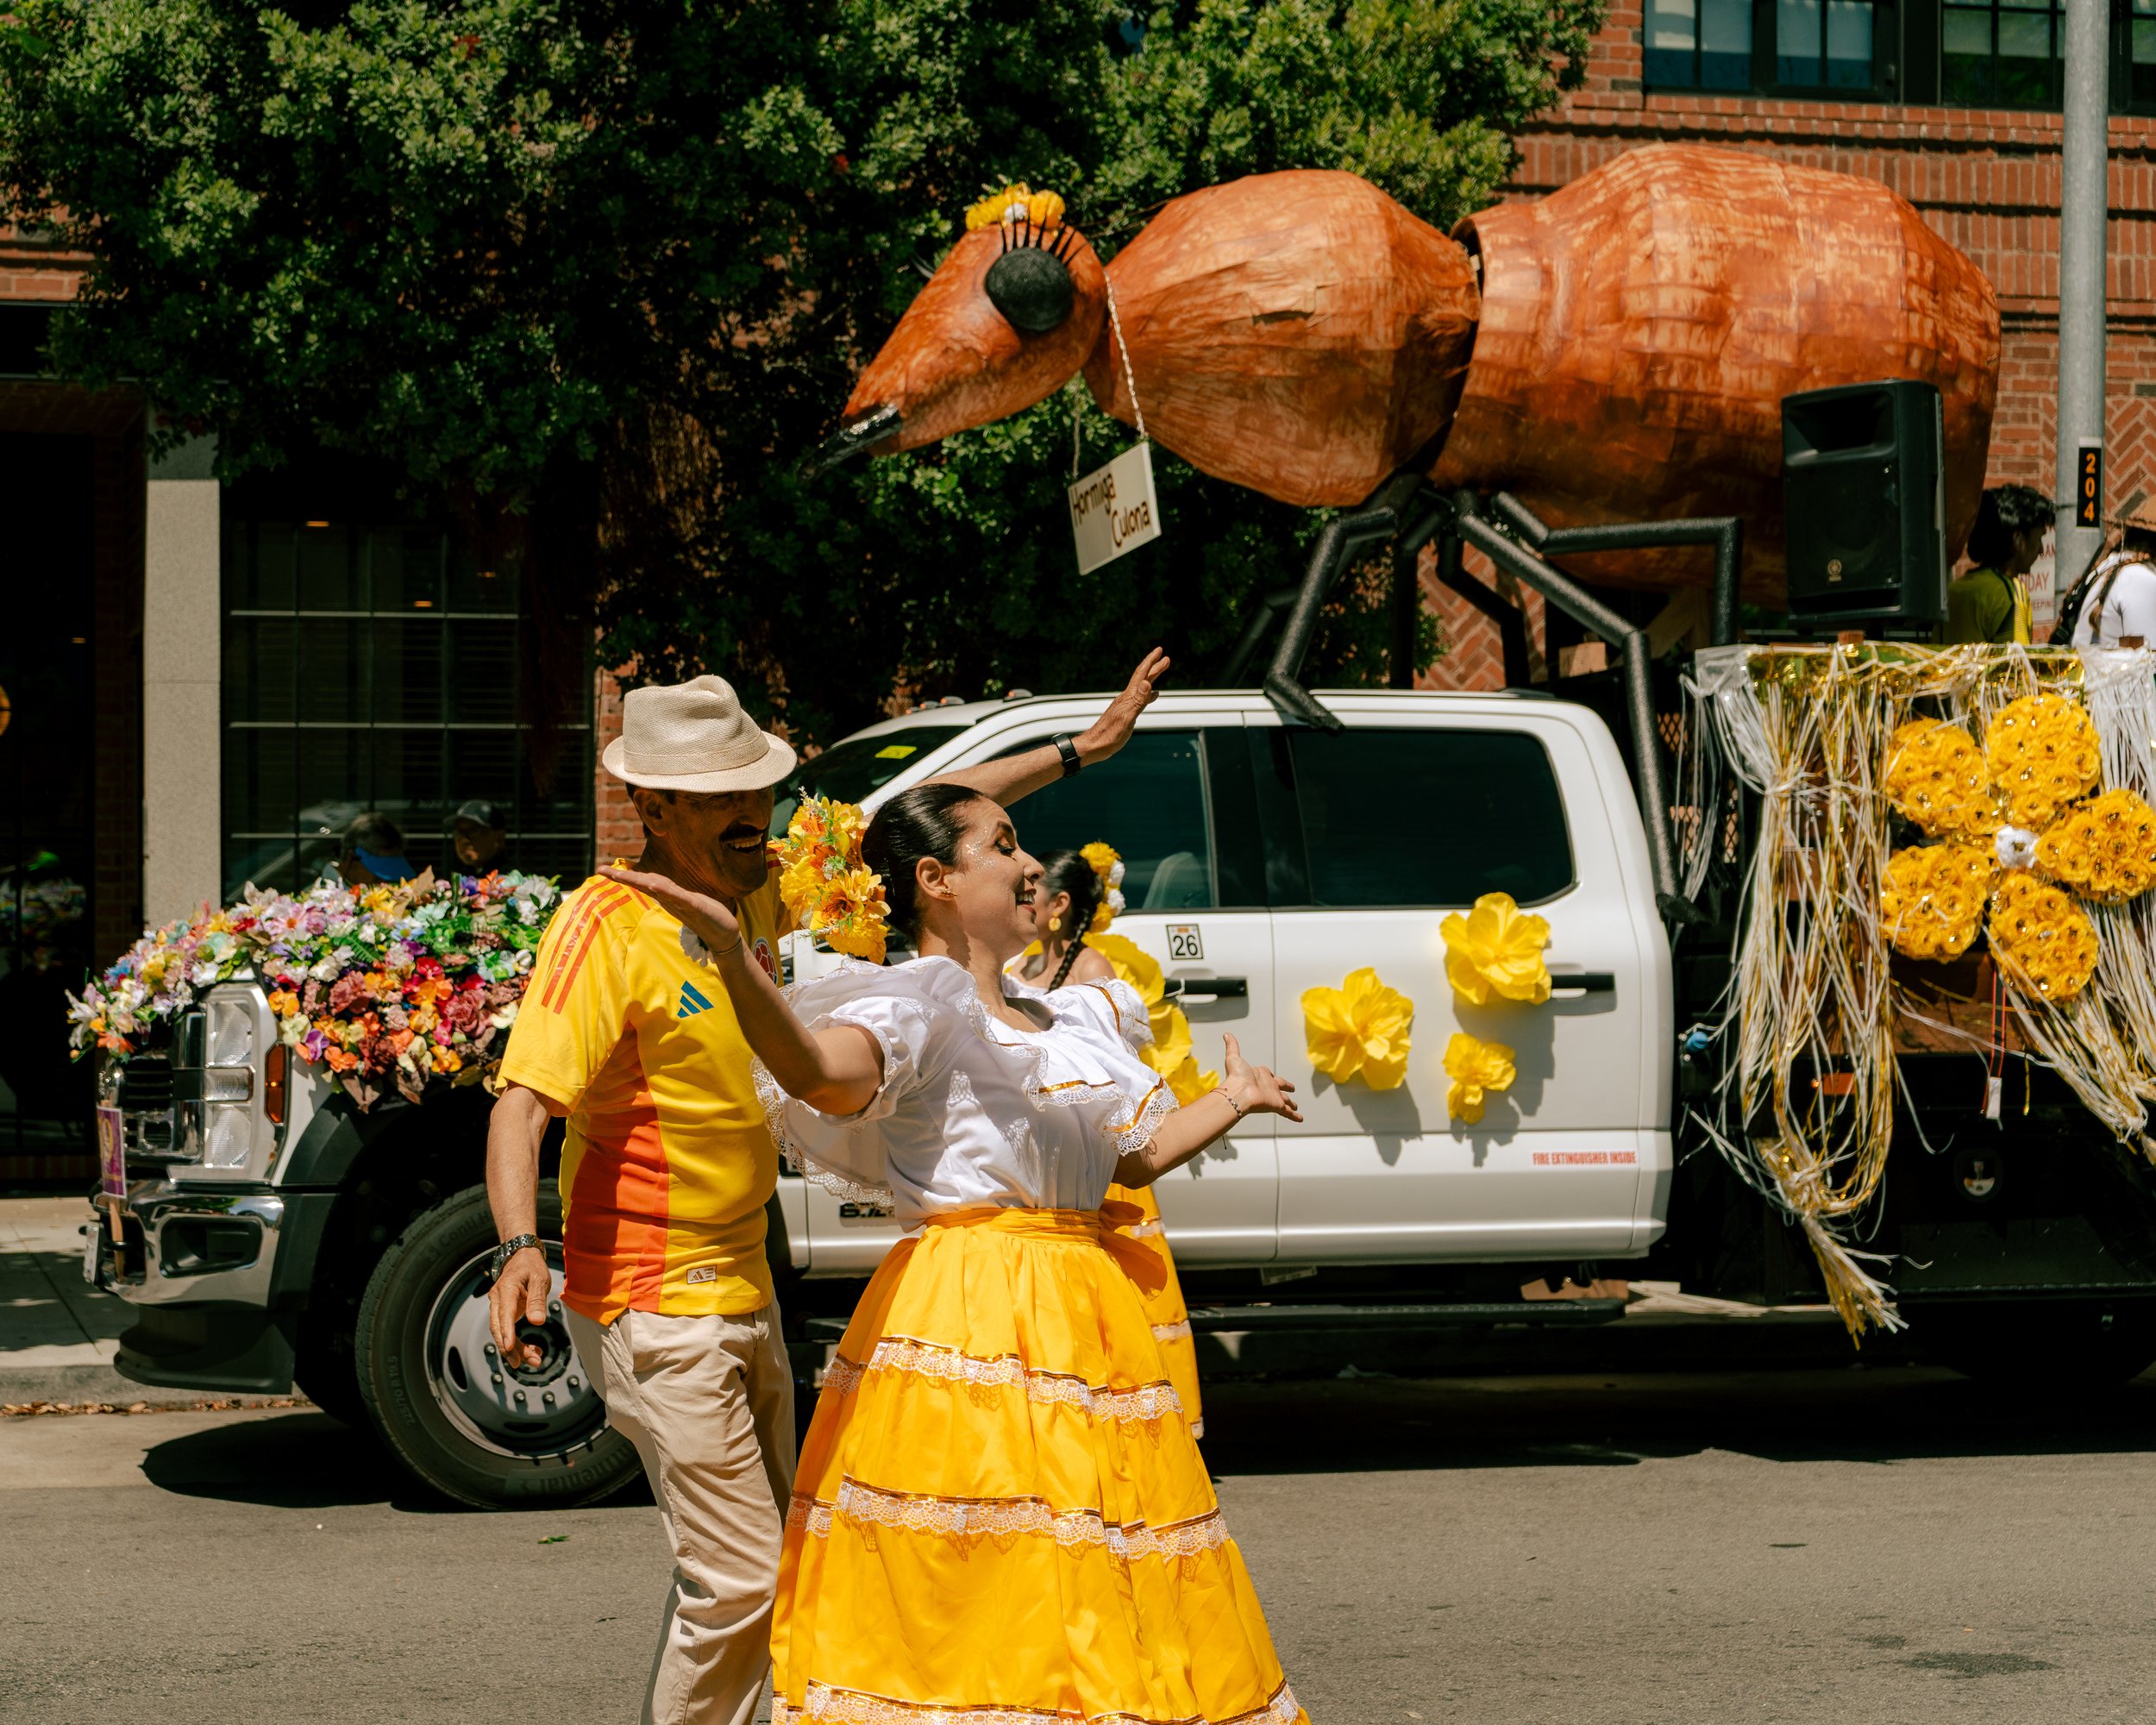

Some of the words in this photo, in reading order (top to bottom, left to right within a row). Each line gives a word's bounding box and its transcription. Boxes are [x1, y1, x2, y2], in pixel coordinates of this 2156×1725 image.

[1073, 474, 1116, 527] Hormiga
[2083, 453, 2096, 522] 204
[1111, 500, 1150, 549] Culona
[1173, 935, 1198, 956] 26
[1532, 1152, 1550, 1165] FIRE
[1551, 1151, 1608, 1165] EXTINGUISHER
[1610, 1151, 1636, 1164] INSIDE
